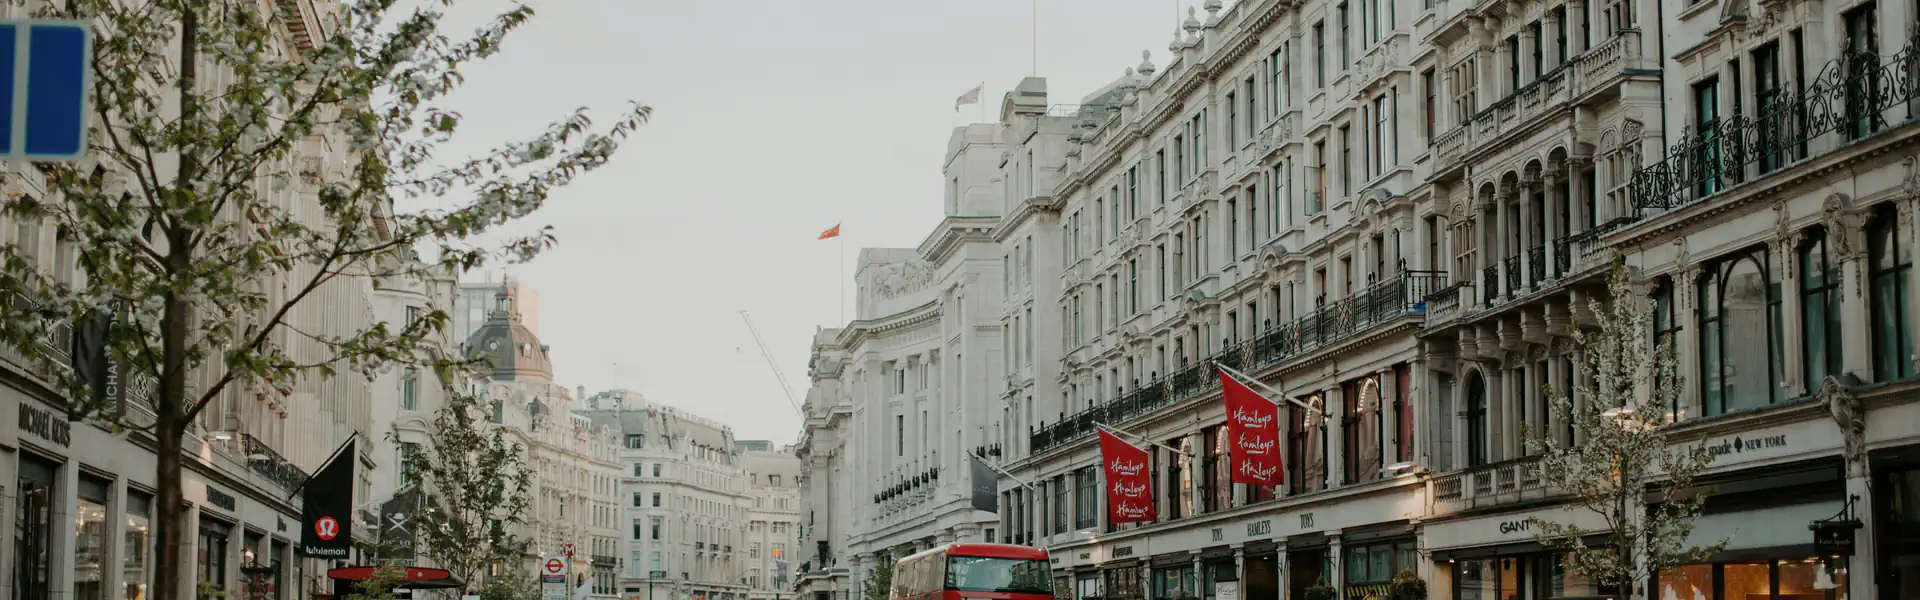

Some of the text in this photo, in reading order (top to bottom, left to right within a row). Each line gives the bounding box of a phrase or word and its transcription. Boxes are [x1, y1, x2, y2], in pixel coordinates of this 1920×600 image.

[1233, 405, 1272, 429] Hamleys
[1708, 439, 1732, 460] spade
[1744, 439, 1762, 451] NEW
[1764, 434, 1787, 448] YORK
[1110, 456, 1144, 476] Hamleys
[1247, 520, 1272, 537] HAMLEYS
[1300, 512, 1314, 529] TOYS
[1499, 519, 1529, 534] GANT
[1212, 527, 1223, 542] TOYS
[305, 545, 346, 556] lululemon
